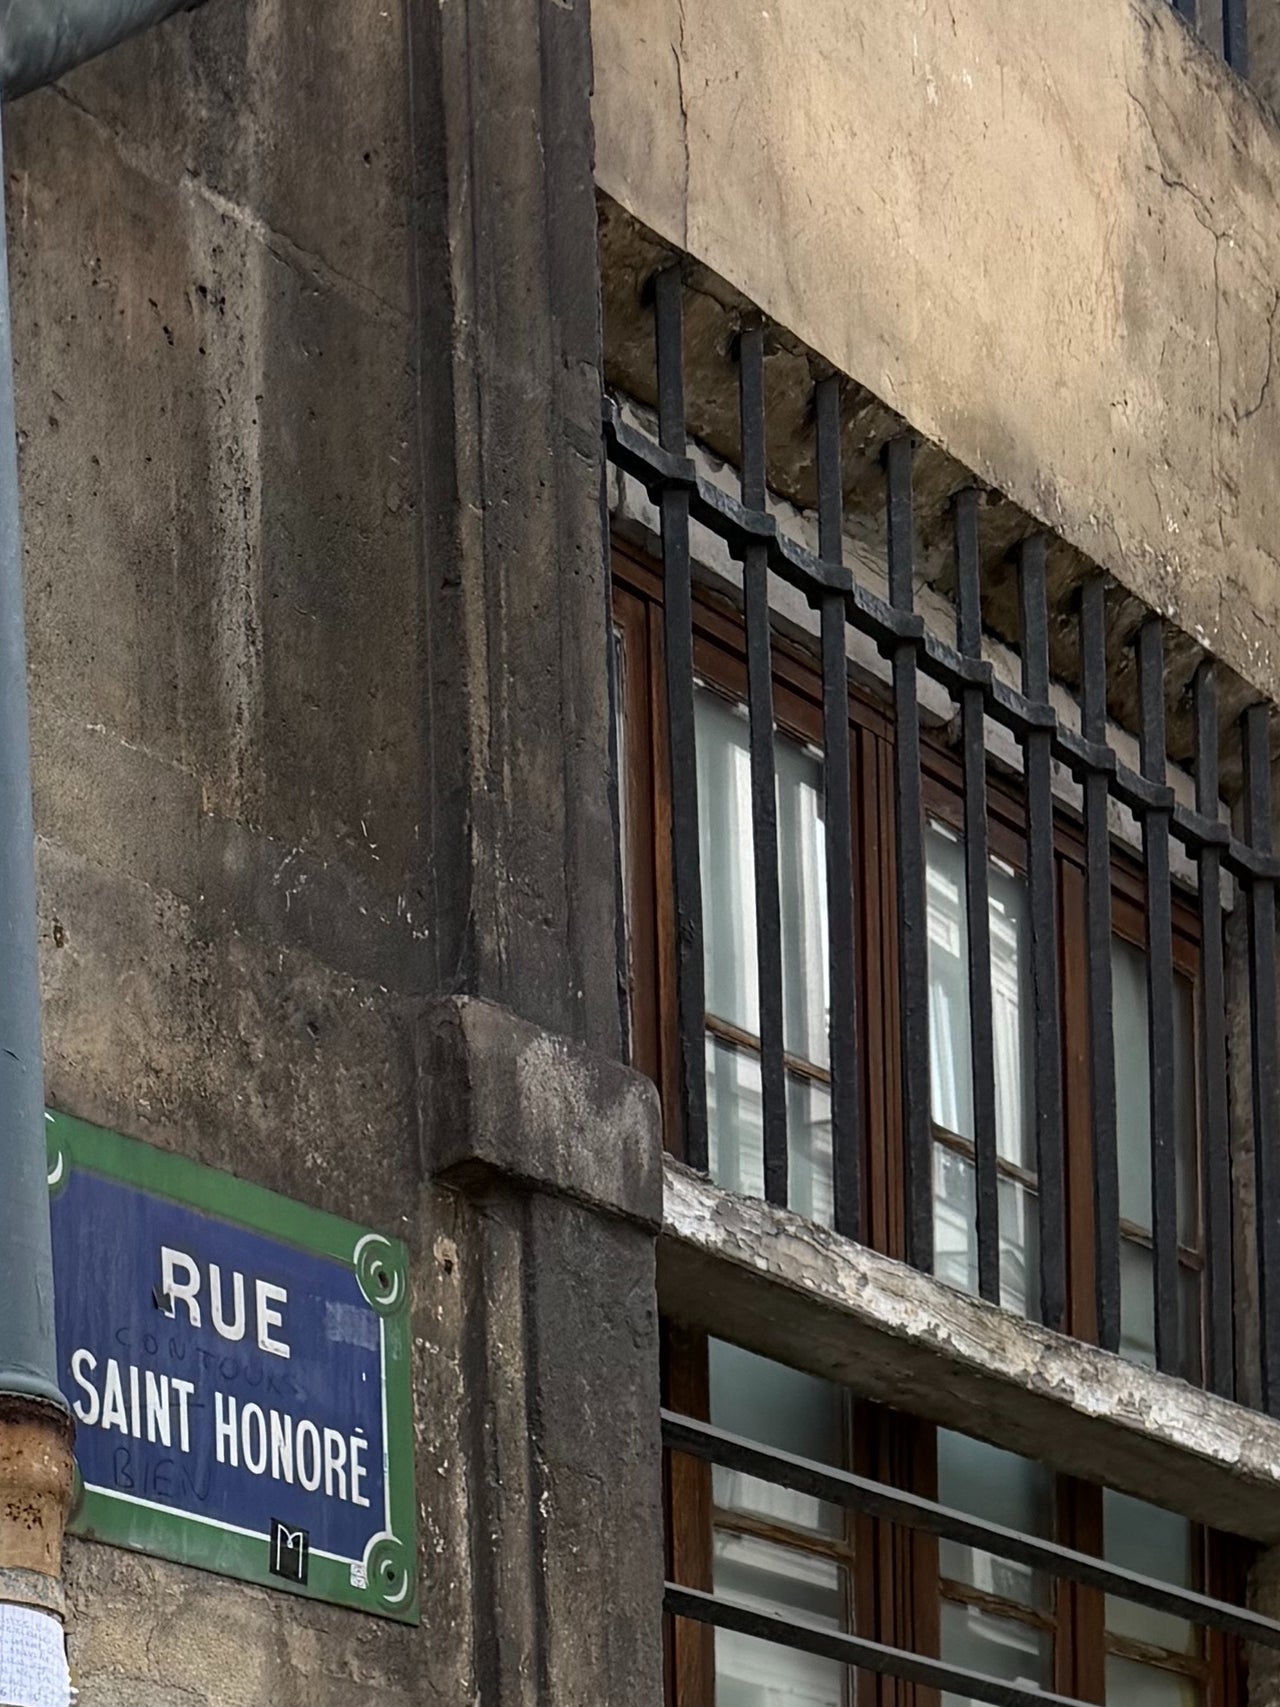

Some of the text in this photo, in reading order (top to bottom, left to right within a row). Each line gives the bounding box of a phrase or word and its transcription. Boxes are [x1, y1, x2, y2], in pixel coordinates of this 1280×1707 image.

[161, 1246, 290, 1358] RUE
[70, 1348, 370, 1507] SAINT HONORÉ
